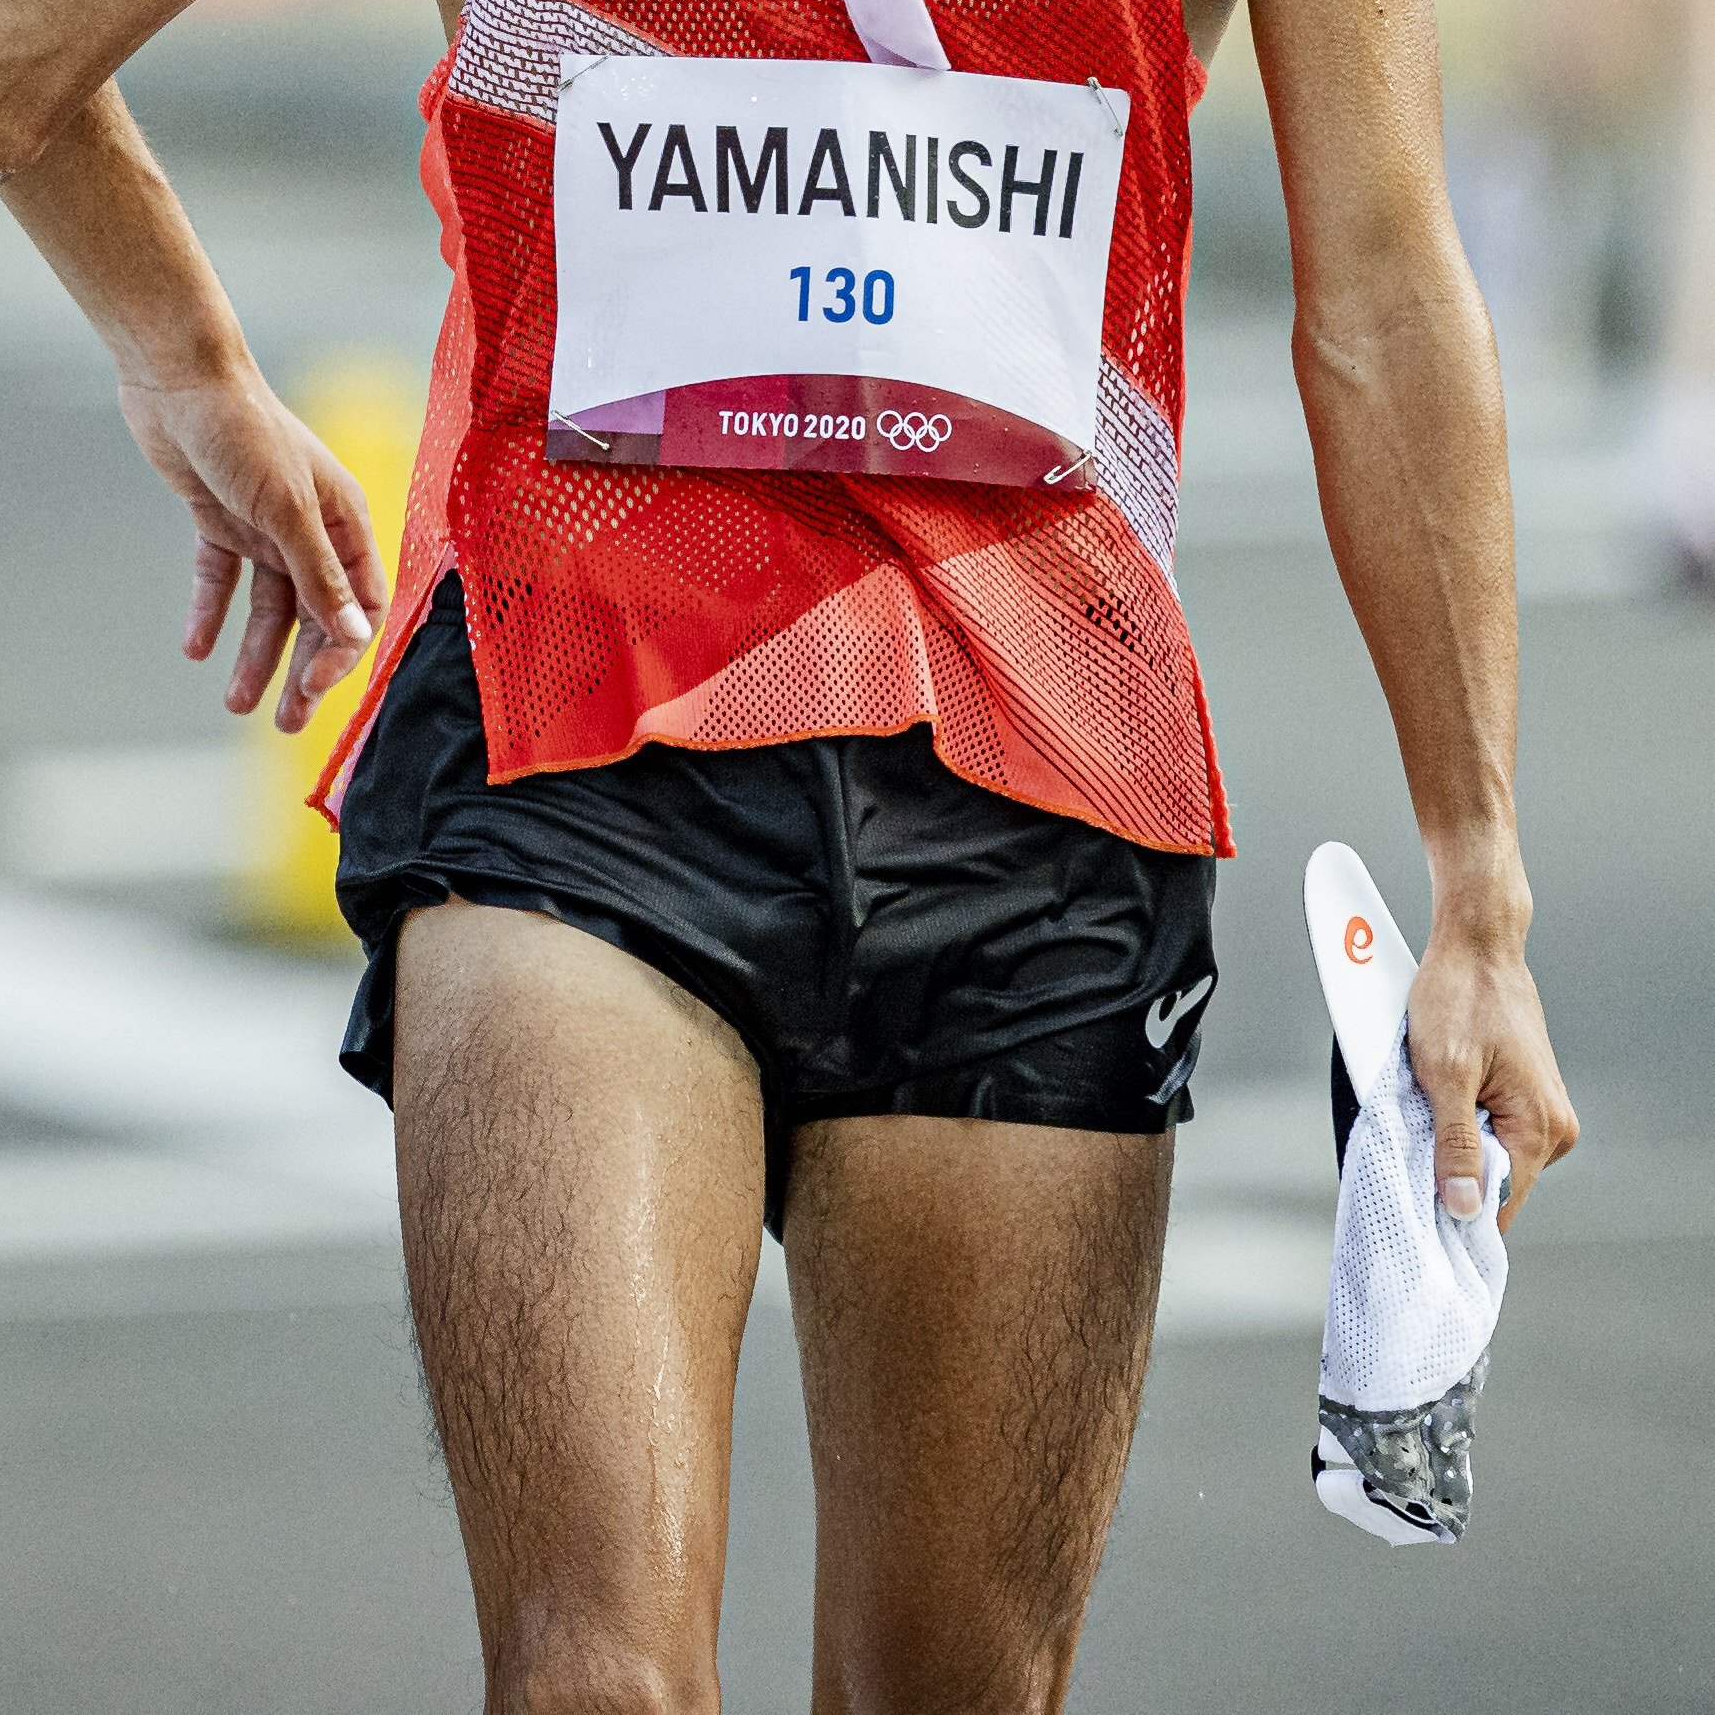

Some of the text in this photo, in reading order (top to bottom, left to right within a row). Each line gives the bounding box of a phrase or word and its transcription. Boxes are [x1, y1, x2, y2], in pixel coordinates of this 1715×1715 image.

[596, 121, 1085, 239] YAMANISHI
[789, 266, 895, 326] 130
[718, 410, 867, 441] TOKYO 2020
